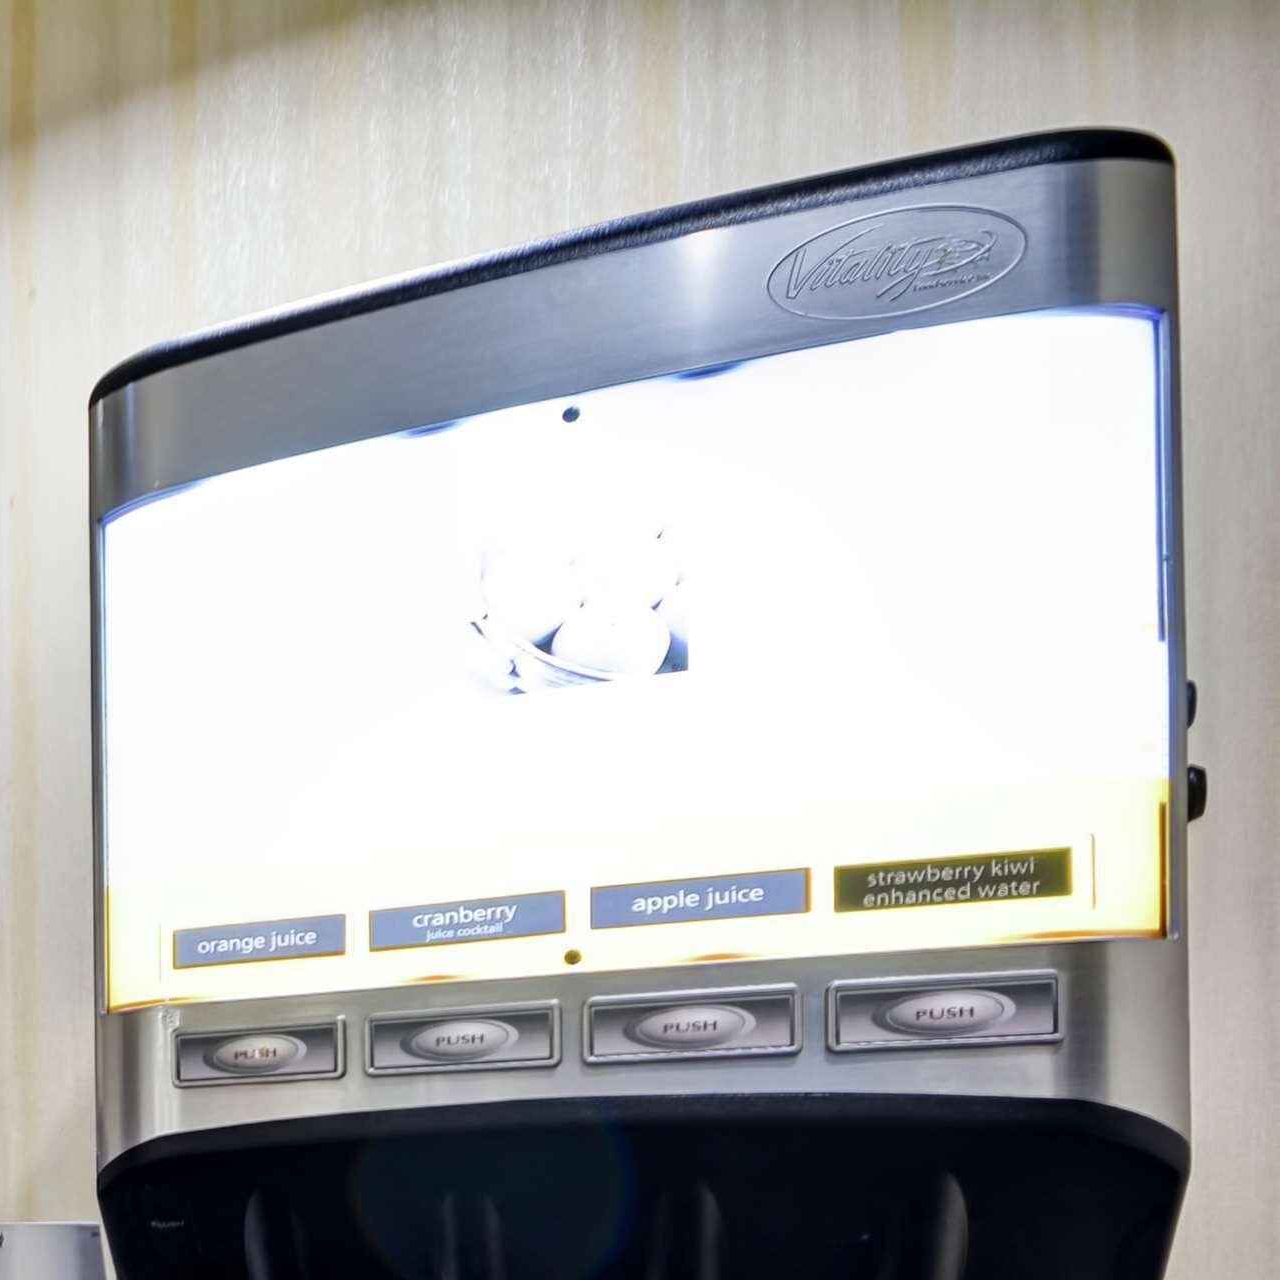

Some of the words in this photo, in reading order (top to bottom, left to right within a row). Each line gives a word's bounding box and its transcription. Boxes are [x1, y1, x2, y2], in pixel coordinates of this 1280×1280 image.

[867, 864, 984, 887] strawberry
[991, 857, 1035, 877] kiwi
[631, 890, 699, 915] apple
[705, 885, 764, 911] juice
[862, 882, 971, 908] enhanced
[978, 880, 1041, 899] water
[412, 904, 517, 929] cranberry
[197, 934, 265, 954] orange
[269, 928, 317, 952] juice
[426, 926, 454, 942] juice
[457, 923, 504, 938] cocktail
[915, 1005, 976, 1021] PUSH
[662, 1020, 719, 1035] PUSH
[435, 1032, 485, 1047] PUSH
[233, 1046, 277, 1061] PUSH
